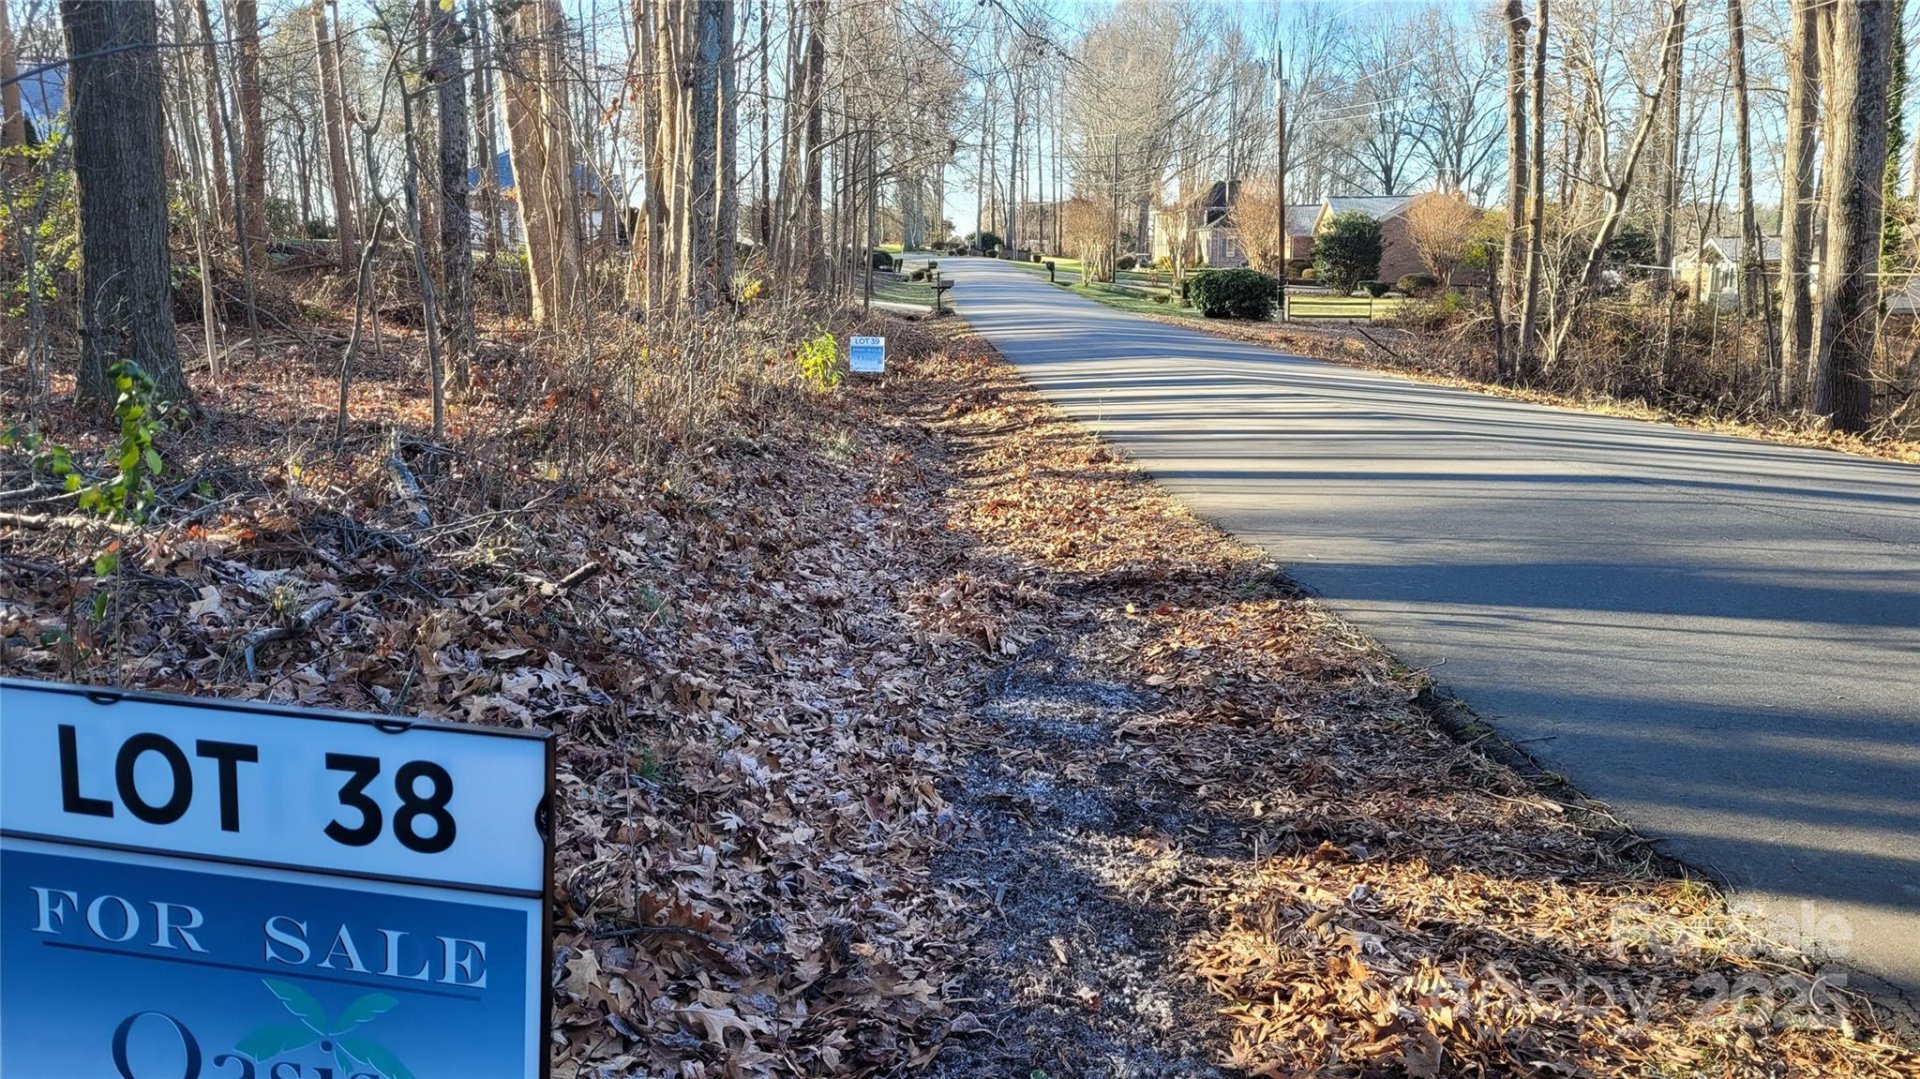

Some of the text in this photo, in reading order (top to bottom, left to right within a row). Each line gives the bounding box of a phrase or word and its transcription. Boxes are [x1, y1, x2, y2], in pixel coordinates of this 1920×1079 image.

[855, 337, 880, 345] LOT 39
[57, 723, 457, 854] LOT 38
[29, 886, 488, 989] FOR SALE
